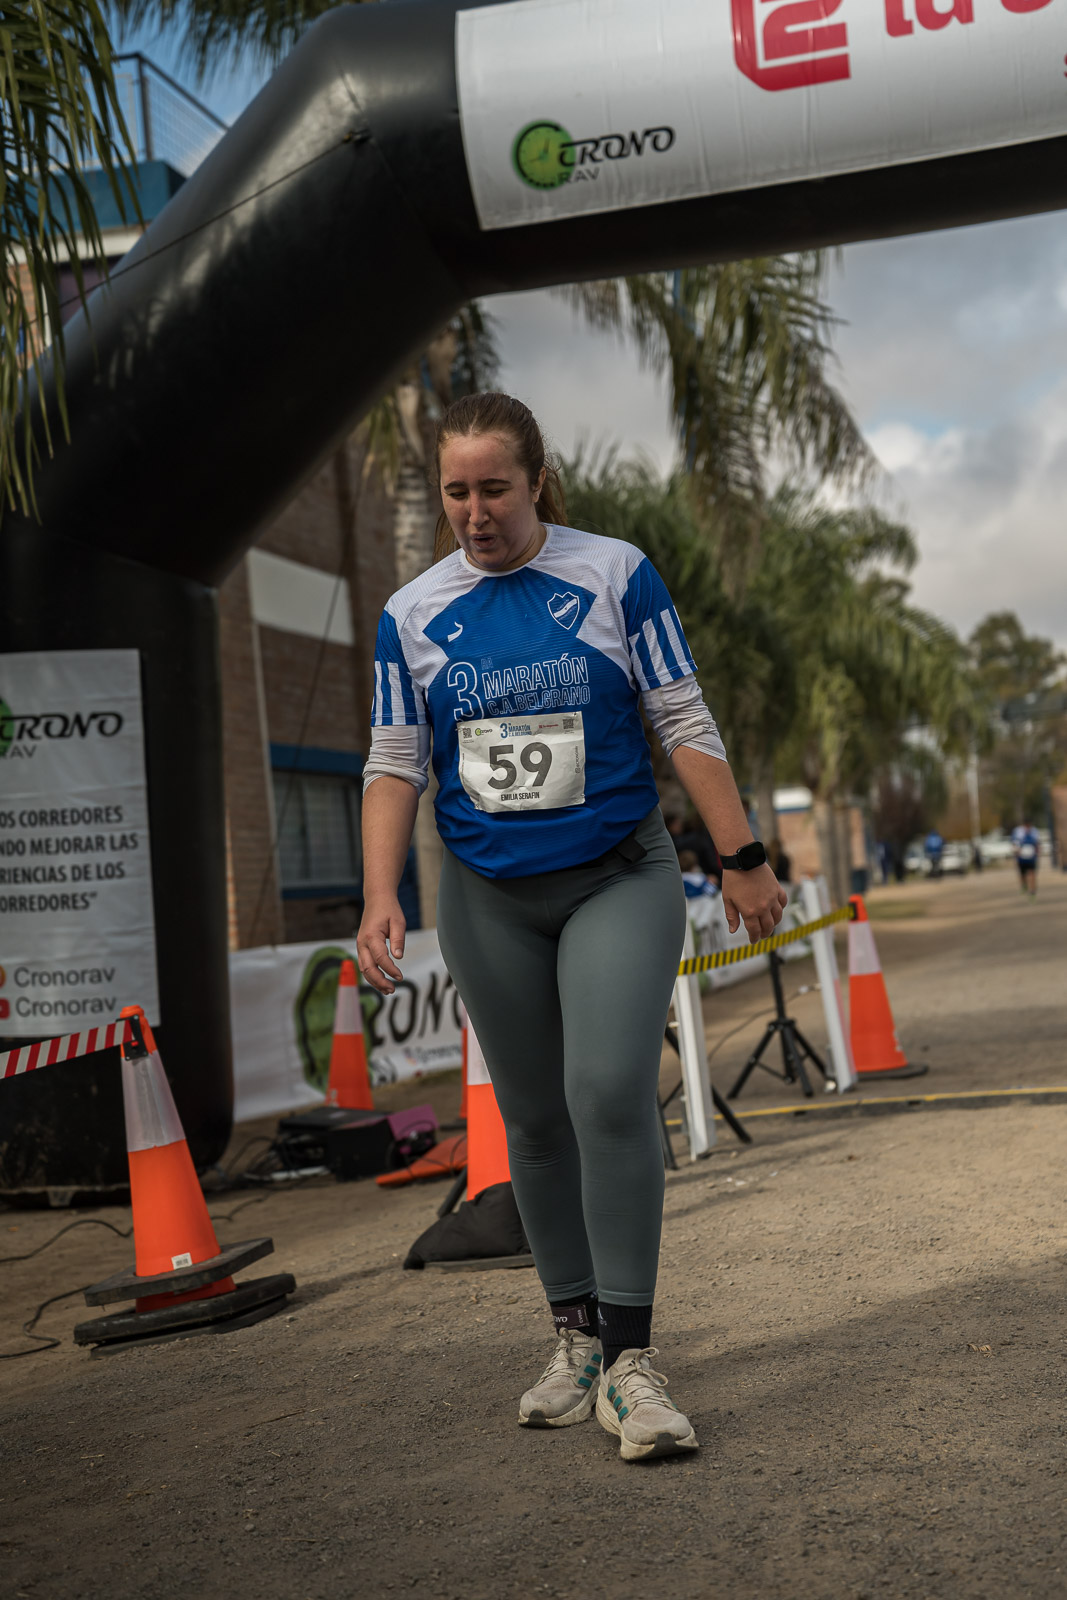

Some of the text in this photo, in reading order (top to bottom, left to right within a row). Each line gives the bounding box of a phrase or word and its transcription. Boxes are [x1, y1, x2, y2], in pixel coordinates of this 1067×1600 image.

[559, 126, 675, 167] CRONO
[557, 167, 600, 184] RAV
[481, 653, 589, 699] MARATÓN
[447, 661, 485, 722] 3
[500, 723, 508, 738] 3
[487, 742, 553, 790] 59
[500, 791, 540, 801] EMILIA SERAFIN
[19, 805, 123, 828] CORREDORES
[30, 834, 106, 855] MEJORAR
[110, 832, 138, 851] LAS
[71, 863, 92, 882] DE
[96, 861, 125, 880] LOS
[14, 966, 116, 988] Cronorav
[15, 996, 117, 1017] Cronorav
